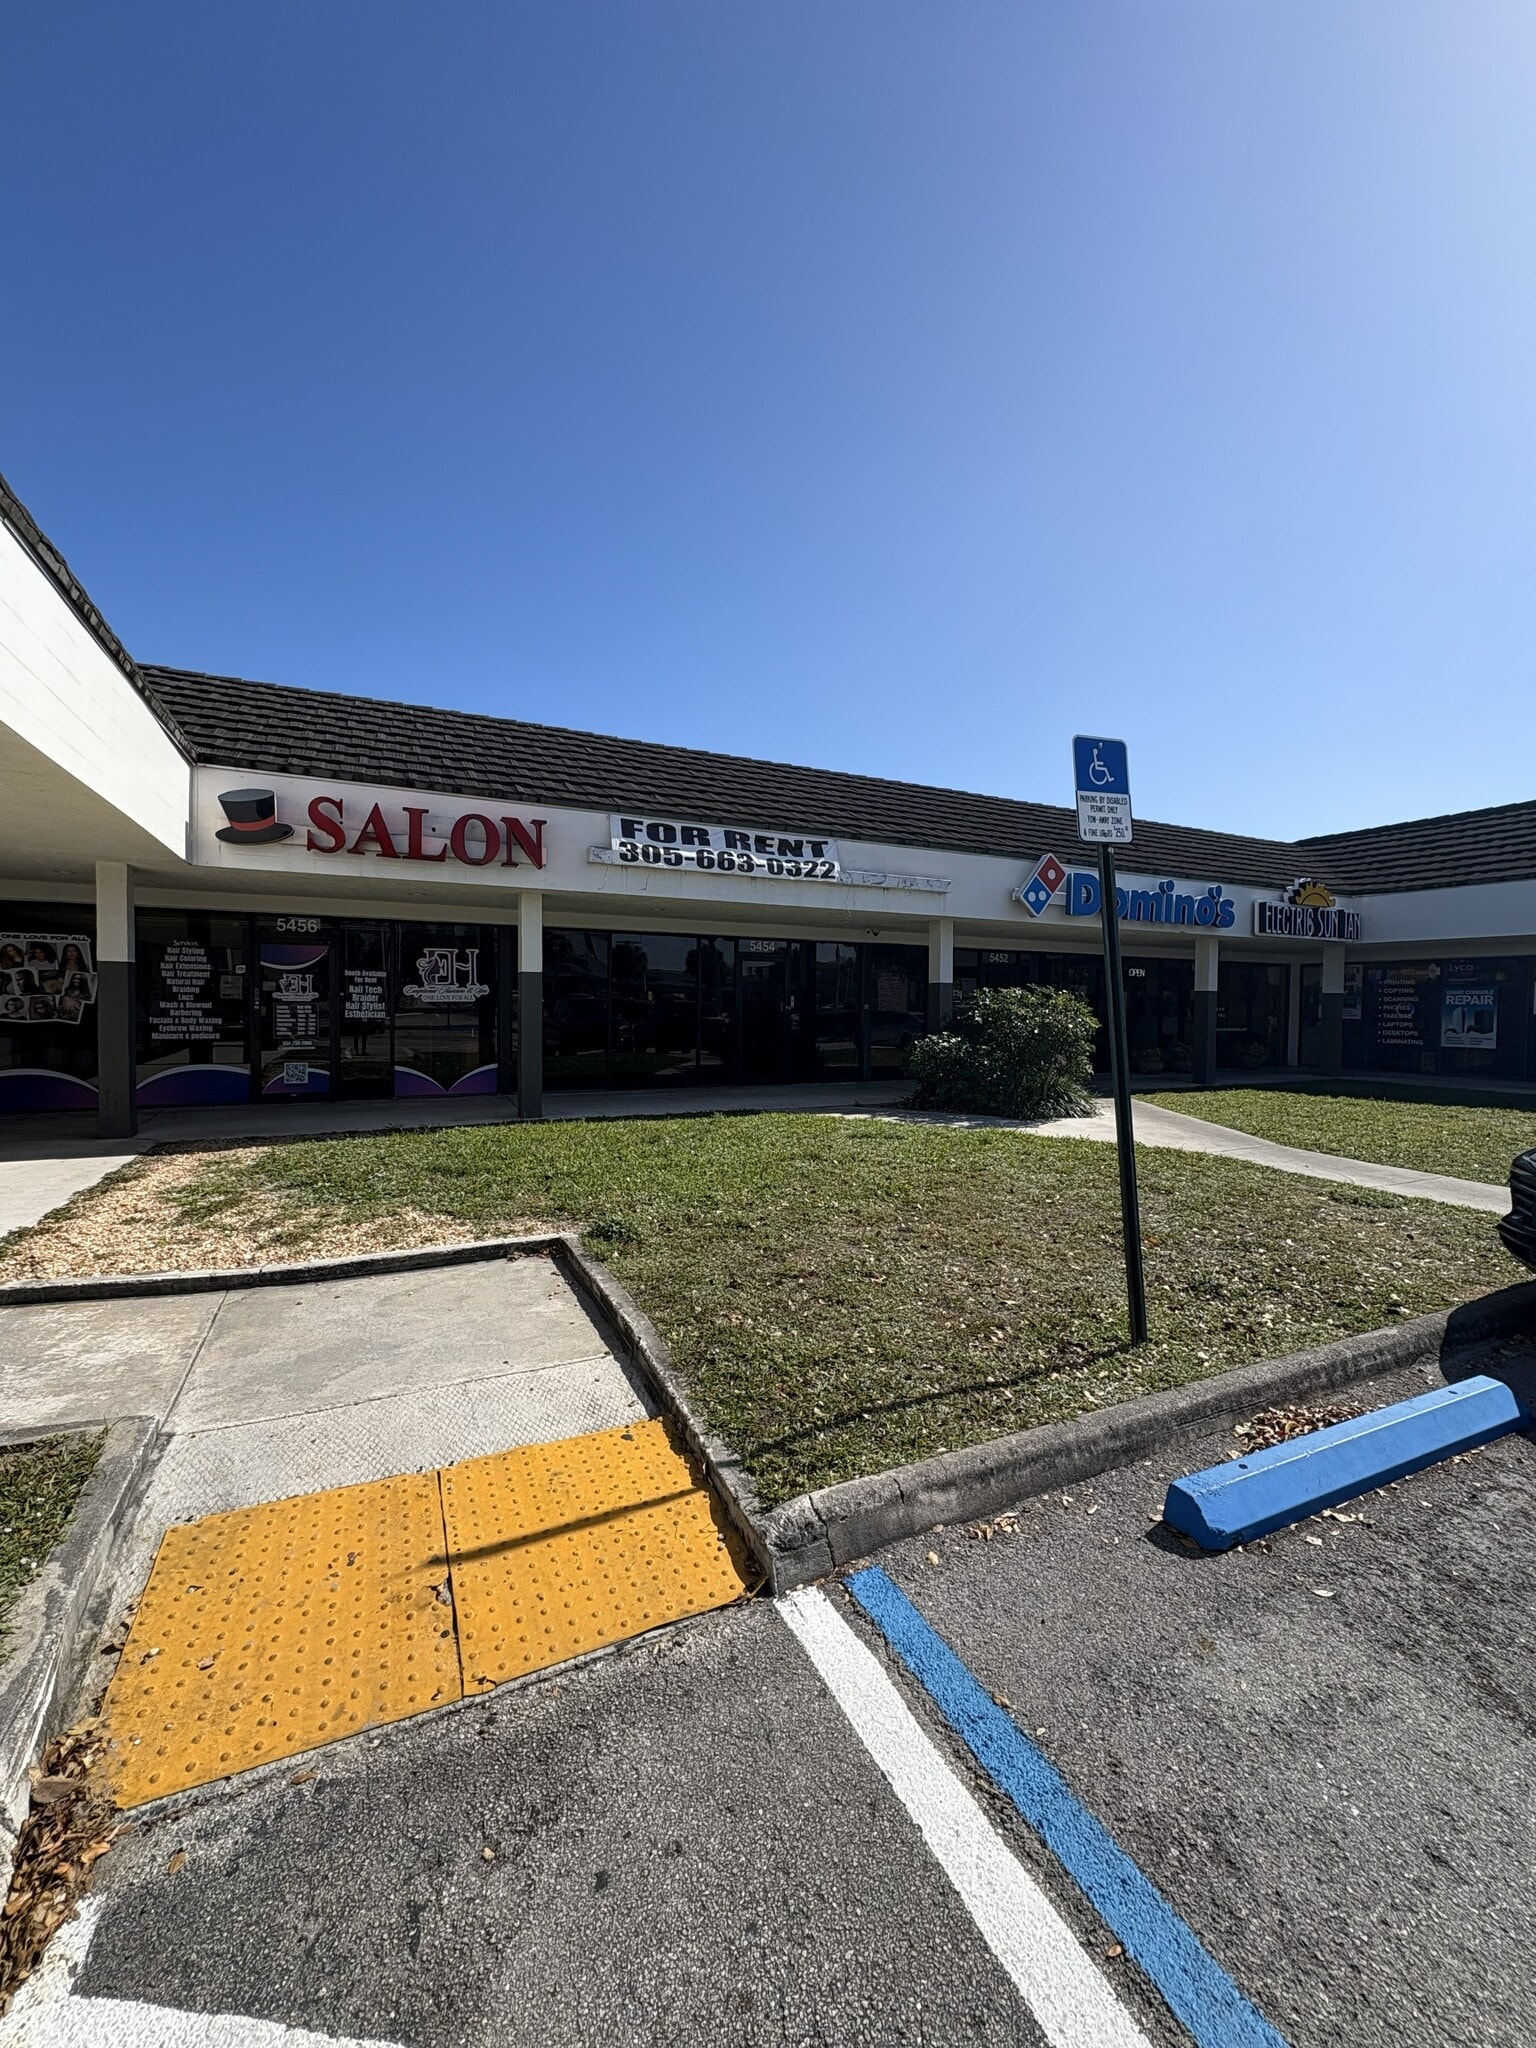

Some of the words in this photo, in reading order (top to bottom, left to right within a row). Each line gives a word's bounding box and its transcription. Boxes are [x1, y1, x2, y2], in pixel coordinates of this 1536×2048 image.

[1080, 795, 1098, 804] PARKING
[1099, 796, 1105, 804] BY
[1106, 796, 1128, 806] DISABLED
[1090, 804, 1105, 812] PERMIT
[1107, 806, 1118, 814] ONLY
[1087, 815, 1109, 824] TOW-AWAY
[1111, 817, 1123, 825] ZONE
[306, 796, 547, 871] SALON
[620, 818, 711, 847] FOR
[723, 829, 828, 858] RENT
[618, 841, 837, 880] 305-663-0322
[276, 918, 318, 933] 5456
[1318, 907, 1338, 938] SUN
[182, 947, 205, 955] Styling
[750, 941, 775, 952] 5454
[180, 955, 207, 963] Coloring
[989, 953, 1009, 963] 5452
[1128, 968, 1146, 977] OPEN
[172, 986, 200, 994] Braiding
[365, 986, 382, 994] Tech
[1446, 995, 1494, 1005] REPAIR
[361, 1002, 385, 1011] Stylist
[345, 1010, 385, 1018] Esthetician
